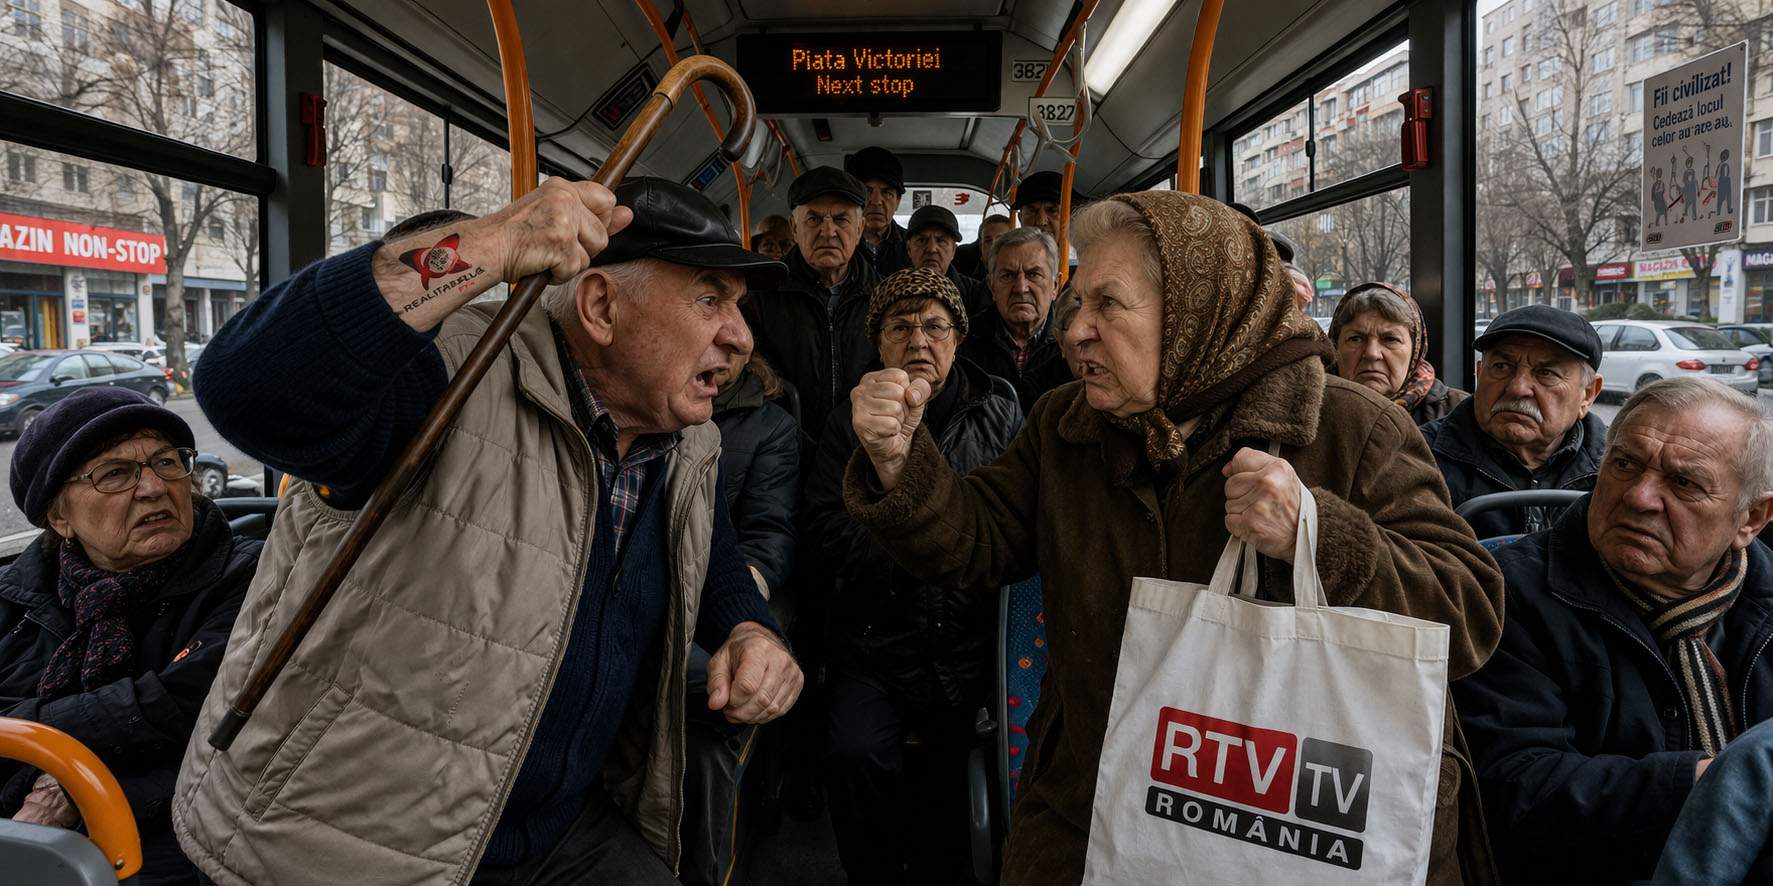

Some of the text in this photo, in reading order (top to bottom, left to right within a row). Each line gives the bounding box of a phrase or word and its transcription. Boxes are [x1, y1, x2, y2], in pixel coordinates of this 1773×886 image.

[792, 48, 941, 70] Piata Victoriei
[1013, 63, 1048, 79] 382
[817, 75, 914, 98] Next stop
[1653, 62, 1732, 109] Fii civilizat!
[1036, 104, 1075, 121] 3827
[1697, 93, 1724, 117] locul
[1651, 131, 1676, 148] celor
[64, 231, 161, 264] NON-STOP
[1160, 720, 1365, 815] RTV TV
[1155, 792, 1350, 864] ROMÂNIA
